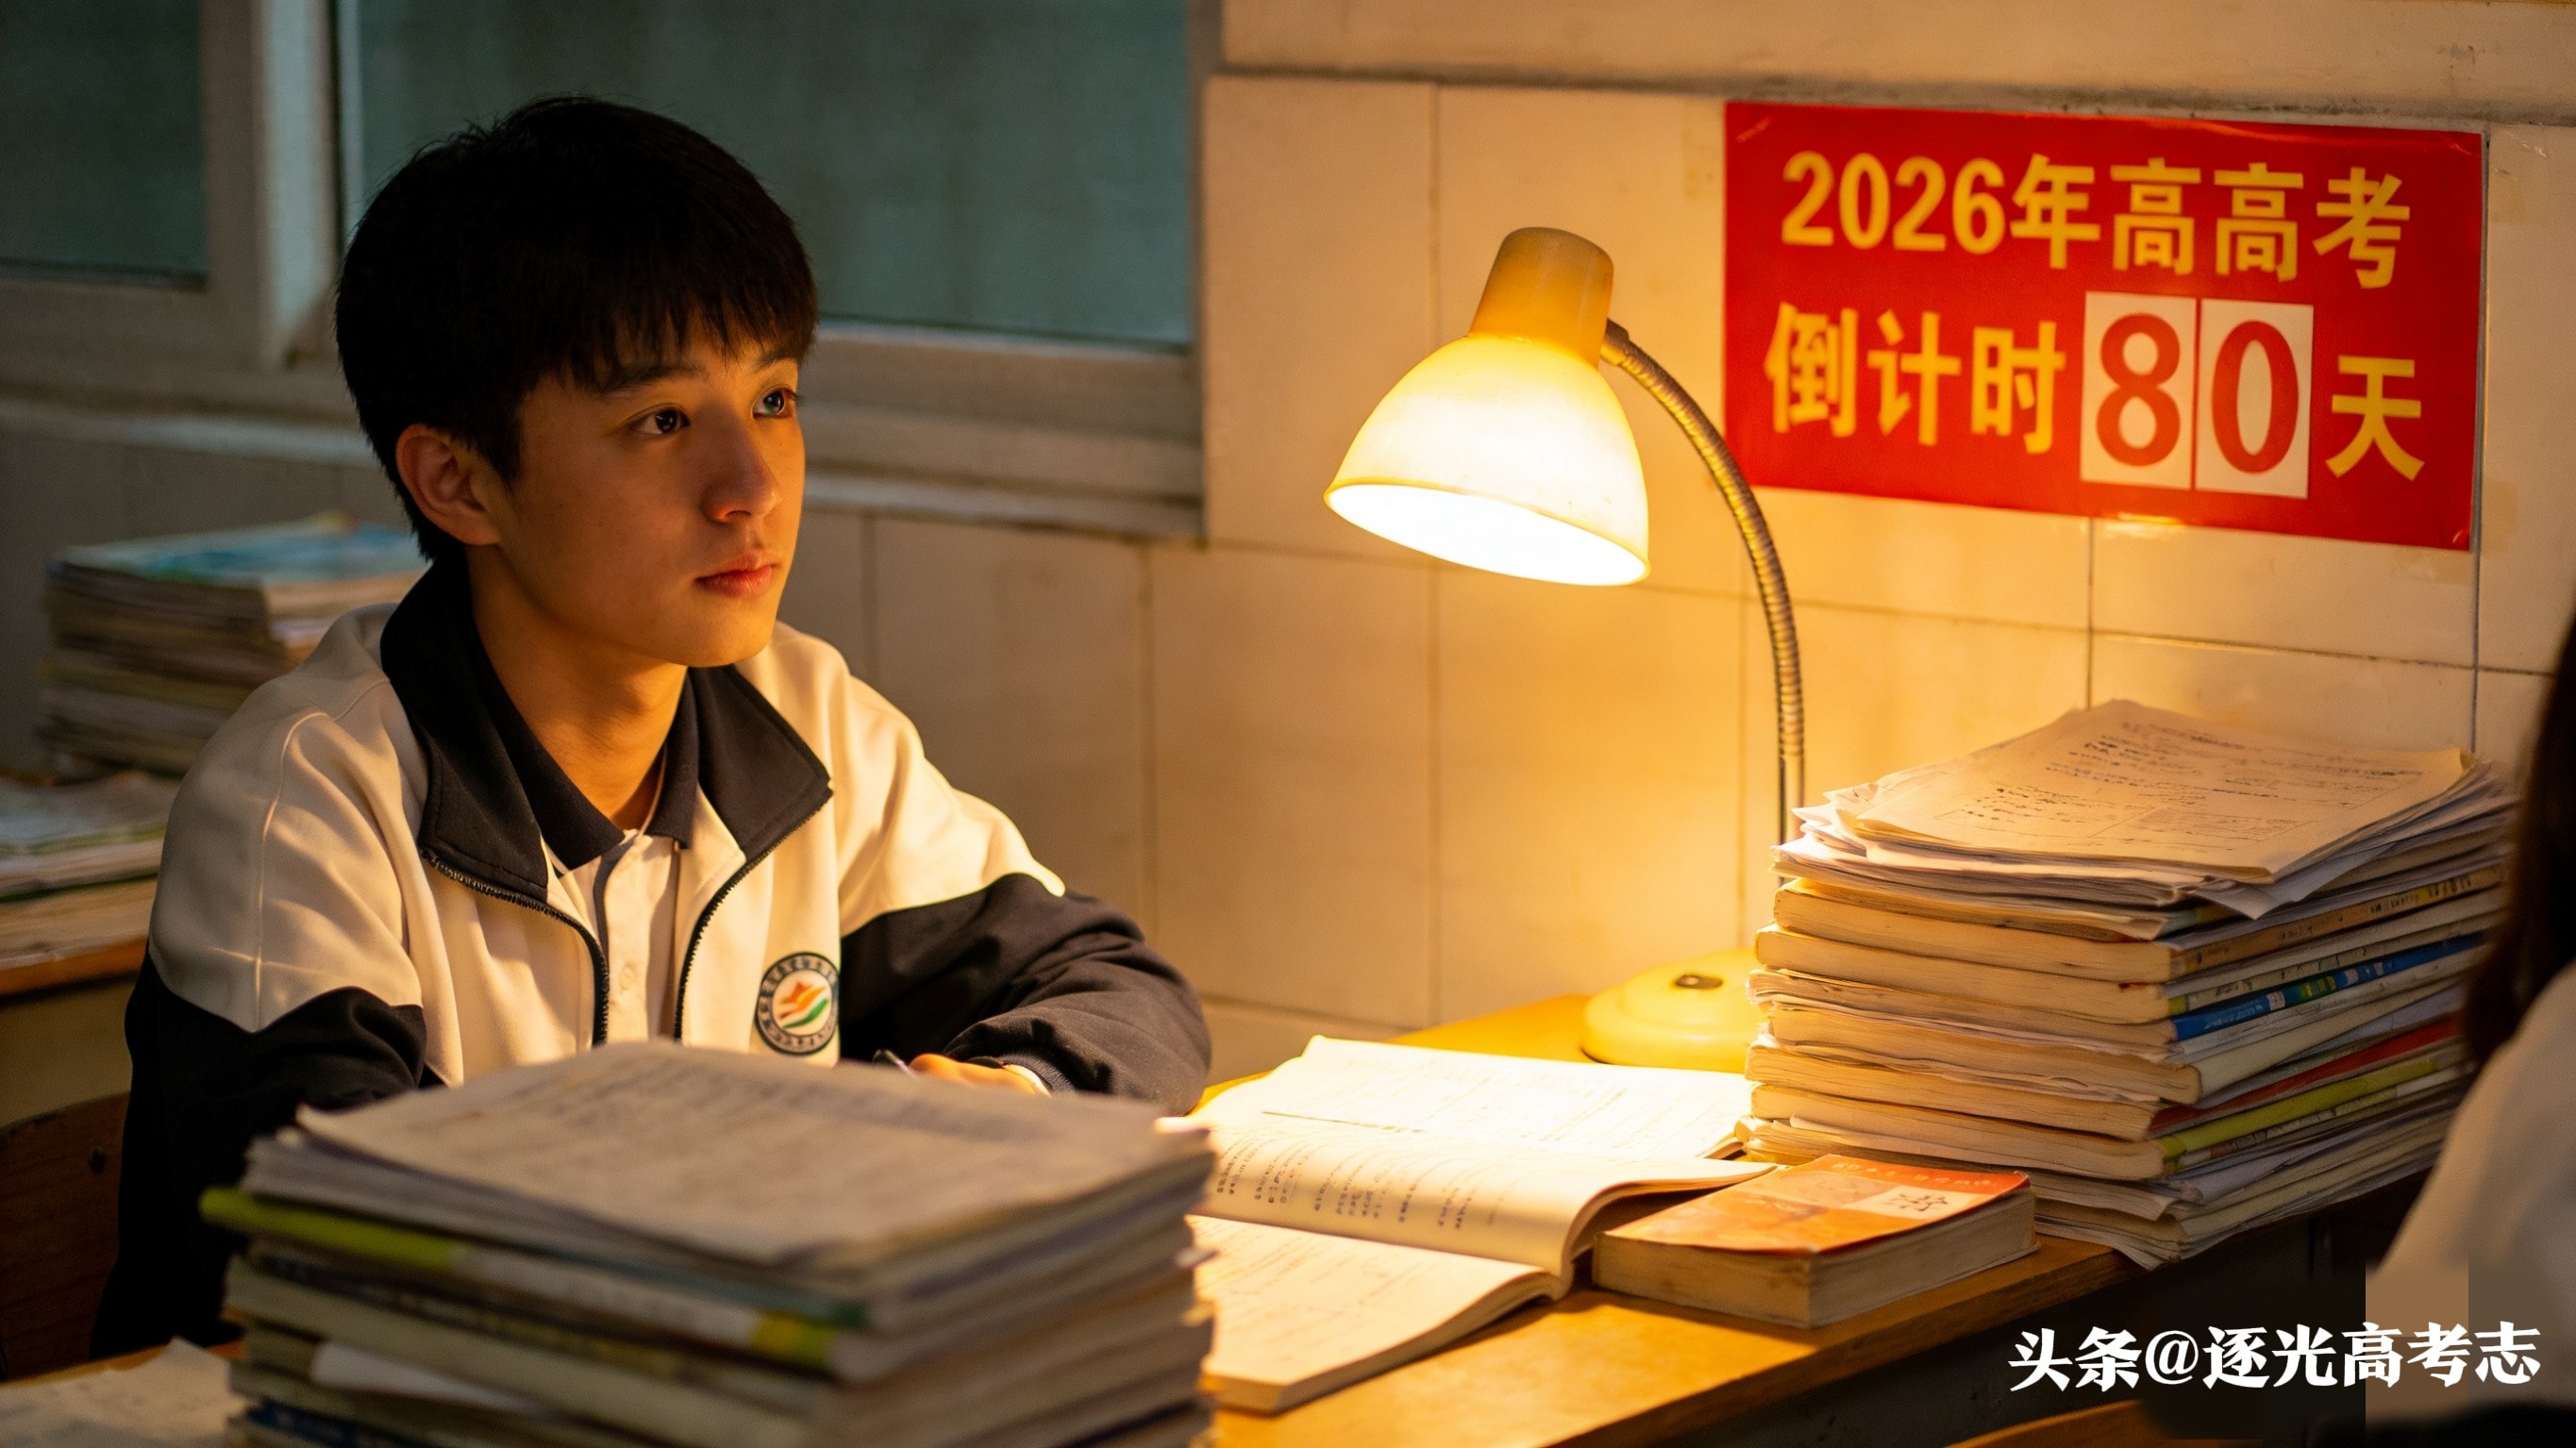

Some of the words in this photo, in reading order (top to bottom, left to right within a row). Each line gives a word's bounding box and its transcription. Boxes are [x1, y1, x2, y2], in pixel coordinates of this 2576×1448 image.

[1781, 151, 2412, 289] 2026年高高考
[1765, 302, 2425, 482] 倒计时80天
